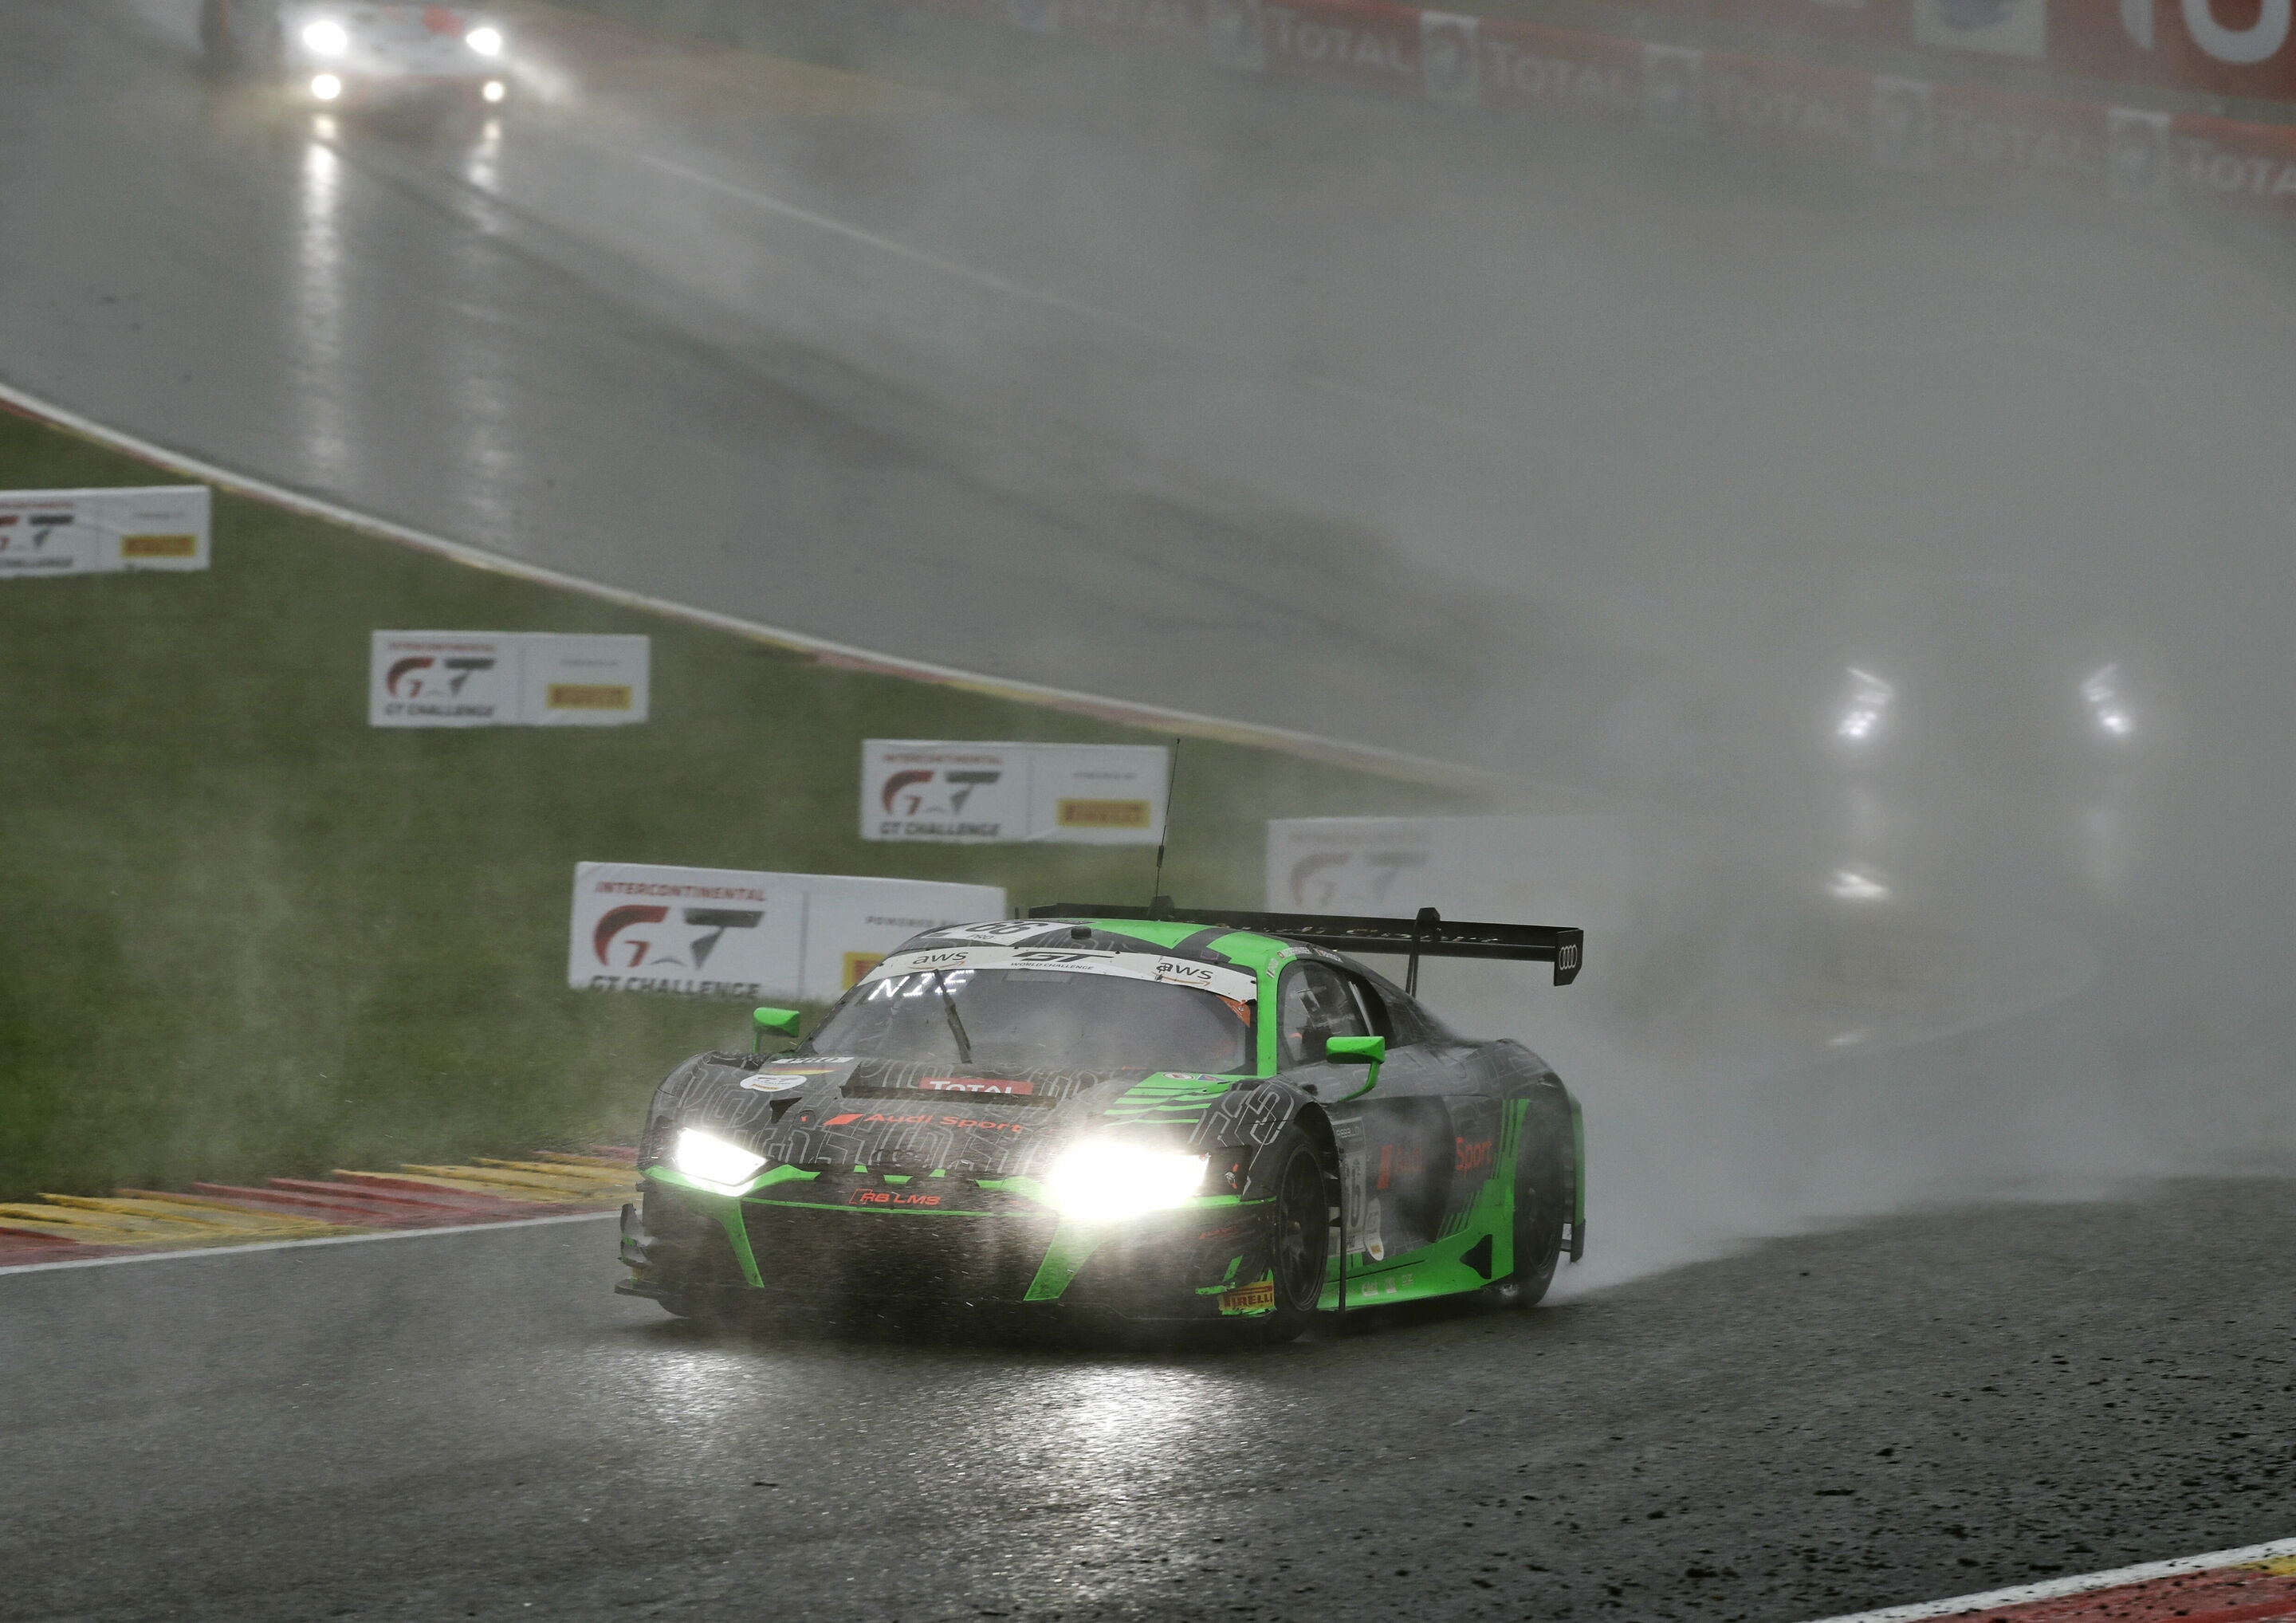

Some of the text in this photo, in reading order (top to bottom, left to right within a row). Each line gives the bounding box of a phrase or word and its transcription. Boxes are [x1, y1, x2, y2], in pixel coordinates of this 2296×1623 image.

[1266, 6, 1415, 75] TOTAL
[1486, 41, 1633, 106] TOTAL
[904, 822, 1001, 836] CHALLENGE
[596, 881, 766, 902] INTERCONTINENTAL
[592, 904, 766, 971] GT
[912, 951, 969, 965] aws
[1043, 962, 1095, 971] CHALLENGE
[1156, 960, 1214, 980] aws
[591, 975, 762, 996] GT CHALLENGE
[863, 1113, 1024, 1133] Audi Sport
[893, 1194, 941, 1206] LMS
[1223, 1284, 1274, 1307] PIRELLI
